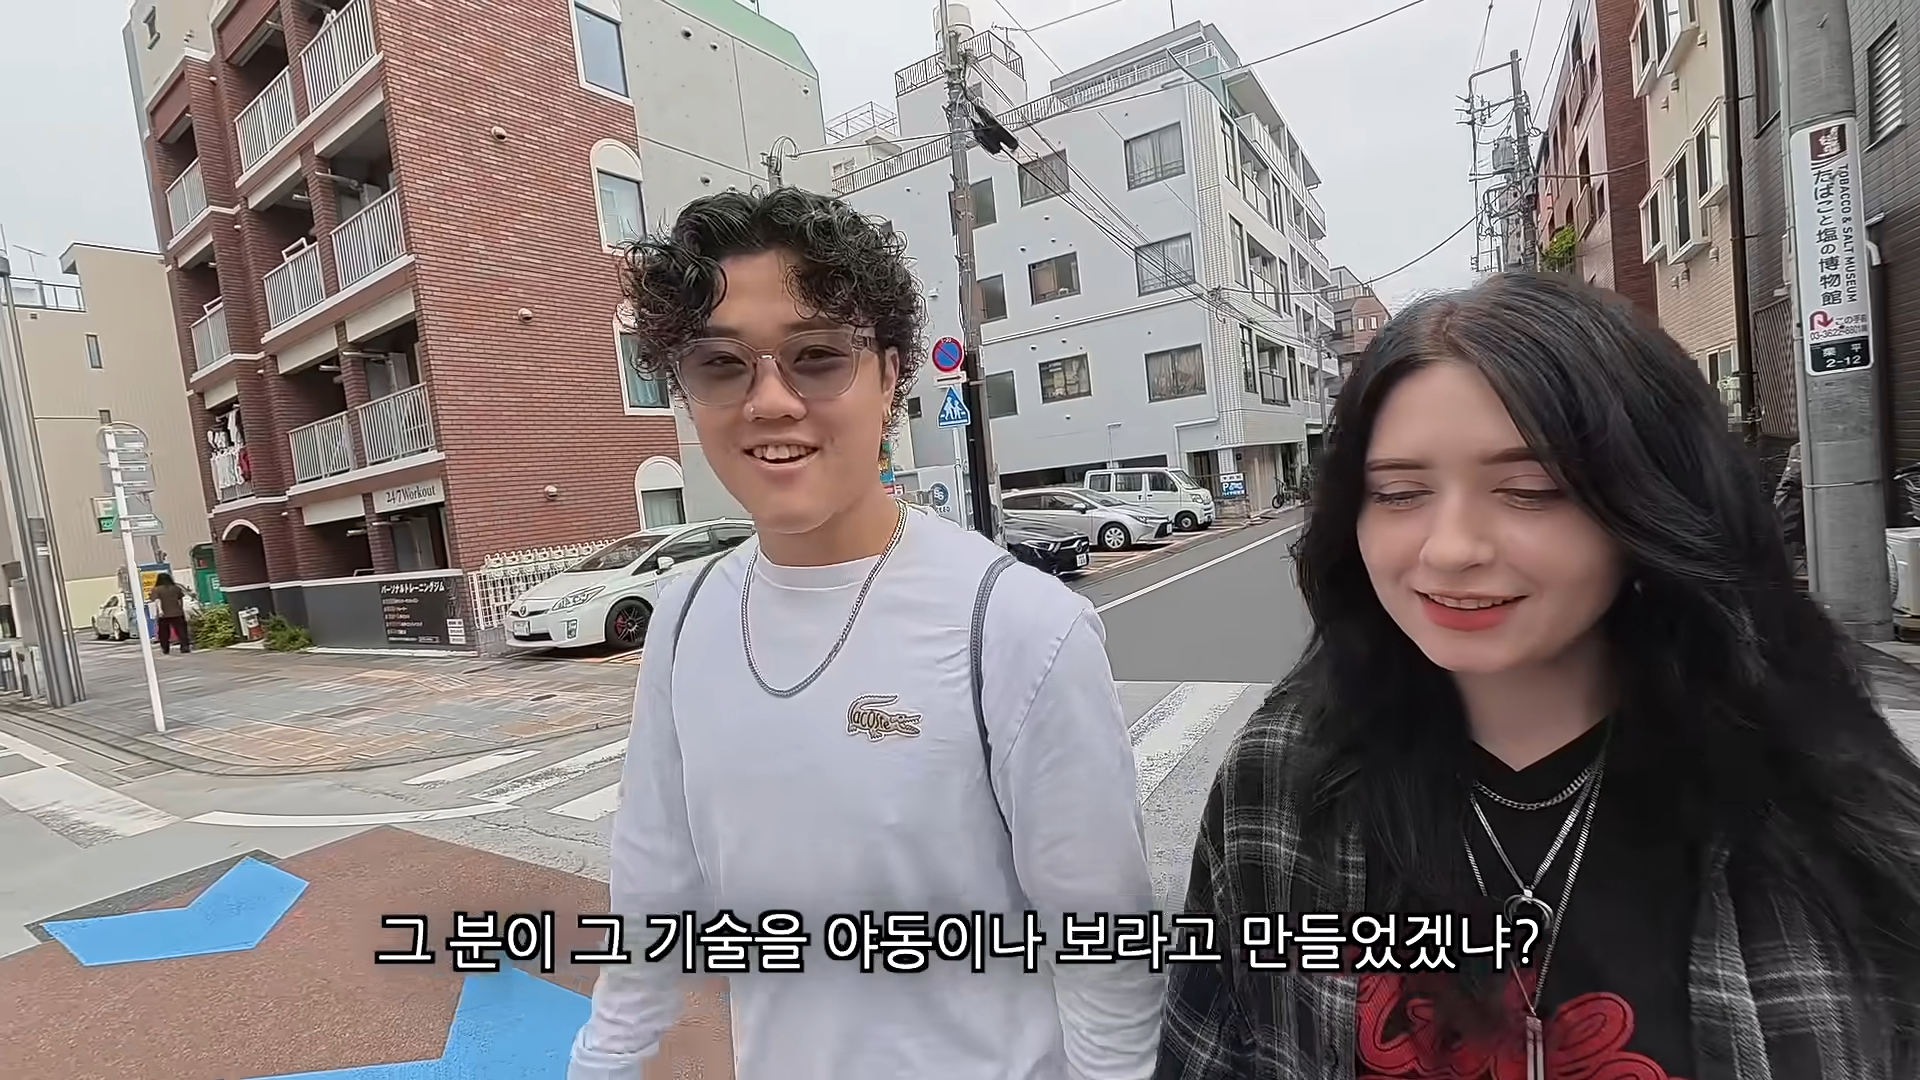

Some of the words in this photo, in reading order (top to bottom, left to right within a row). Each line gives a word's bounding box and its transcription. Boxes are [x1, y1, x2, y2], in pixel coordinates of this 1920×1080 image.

[1838, 163, 1851, 214] TOBACCO
[1813, 169, 1842, 307] たばこと塩の博物館
[1841, 216, 1853, 224] &
[1842, 226, 1855, 254] SALT
[1844, 256, 1858, 303] MUSEUM
[1825, 354, 1862, 368] 2-12
